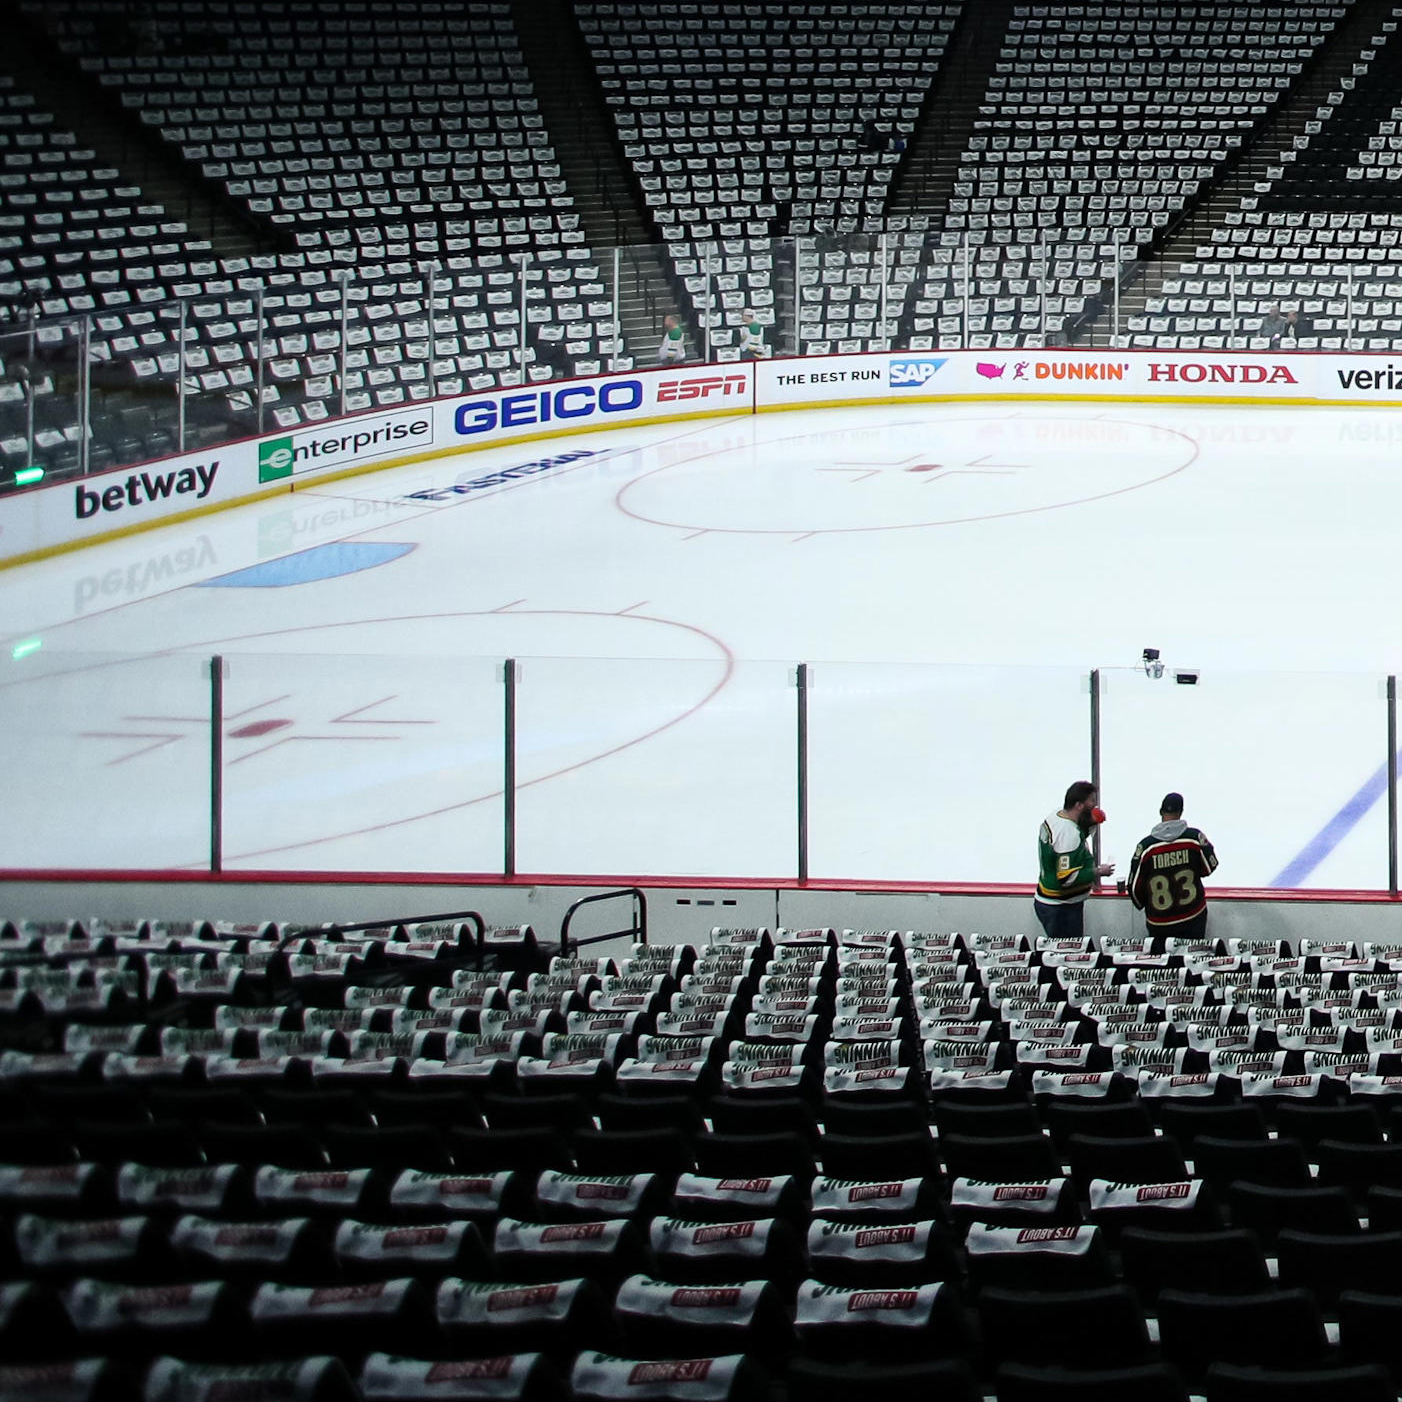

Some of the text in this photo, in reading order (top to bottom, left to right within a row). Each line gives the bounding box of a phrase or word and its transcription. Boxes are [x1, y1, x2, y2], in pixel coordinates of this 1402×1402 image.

[777, 363, 935, 386] THE BEST RUN SAP
[1035, 363, 1130, 381] DUNKIN'
[1147, 363, 1299, 384] HONDA
[656, 374, 747, 403] ESPN
[454, 379, 643, 436] GEICO
[261, 417, 430, 470] enterprise
[74, 462, 220, 520] betway
[1150, 869, 1197, 911] 83
[1020, 1229, 1053, 1242] ABOUT
